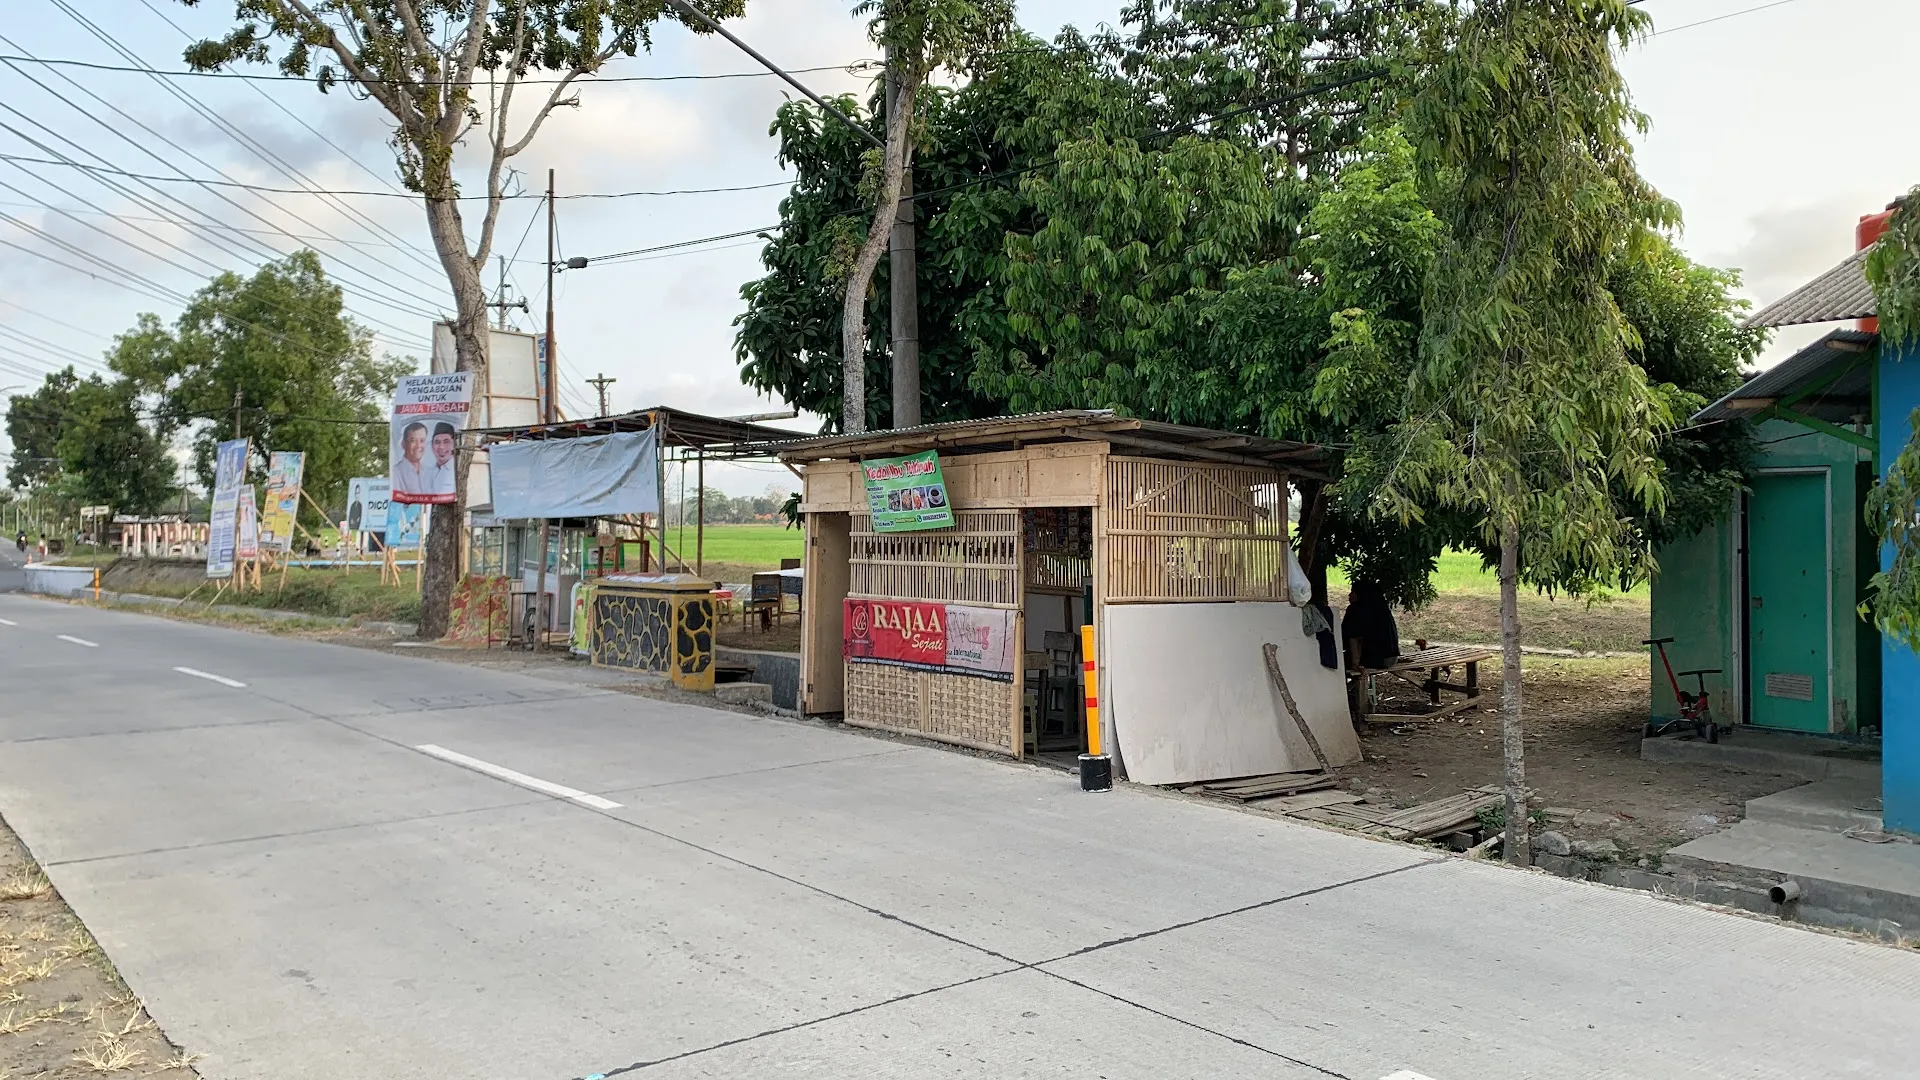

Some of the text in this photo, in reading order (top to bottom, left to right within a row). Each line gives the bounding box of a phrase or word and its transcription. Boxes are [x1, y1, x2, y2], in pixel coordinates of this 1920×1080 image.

[405, 375, 466, 387] MELANJUTKAN
[407, 385, 462, 395] PENGABDIAN
[418, 394, 447, 402] UNTUK
[401, 402, 465, 414] JAWA TENGAH
[872, 604, 942, 639] RAJAA
[912, 633, 944, 653] Sejati
